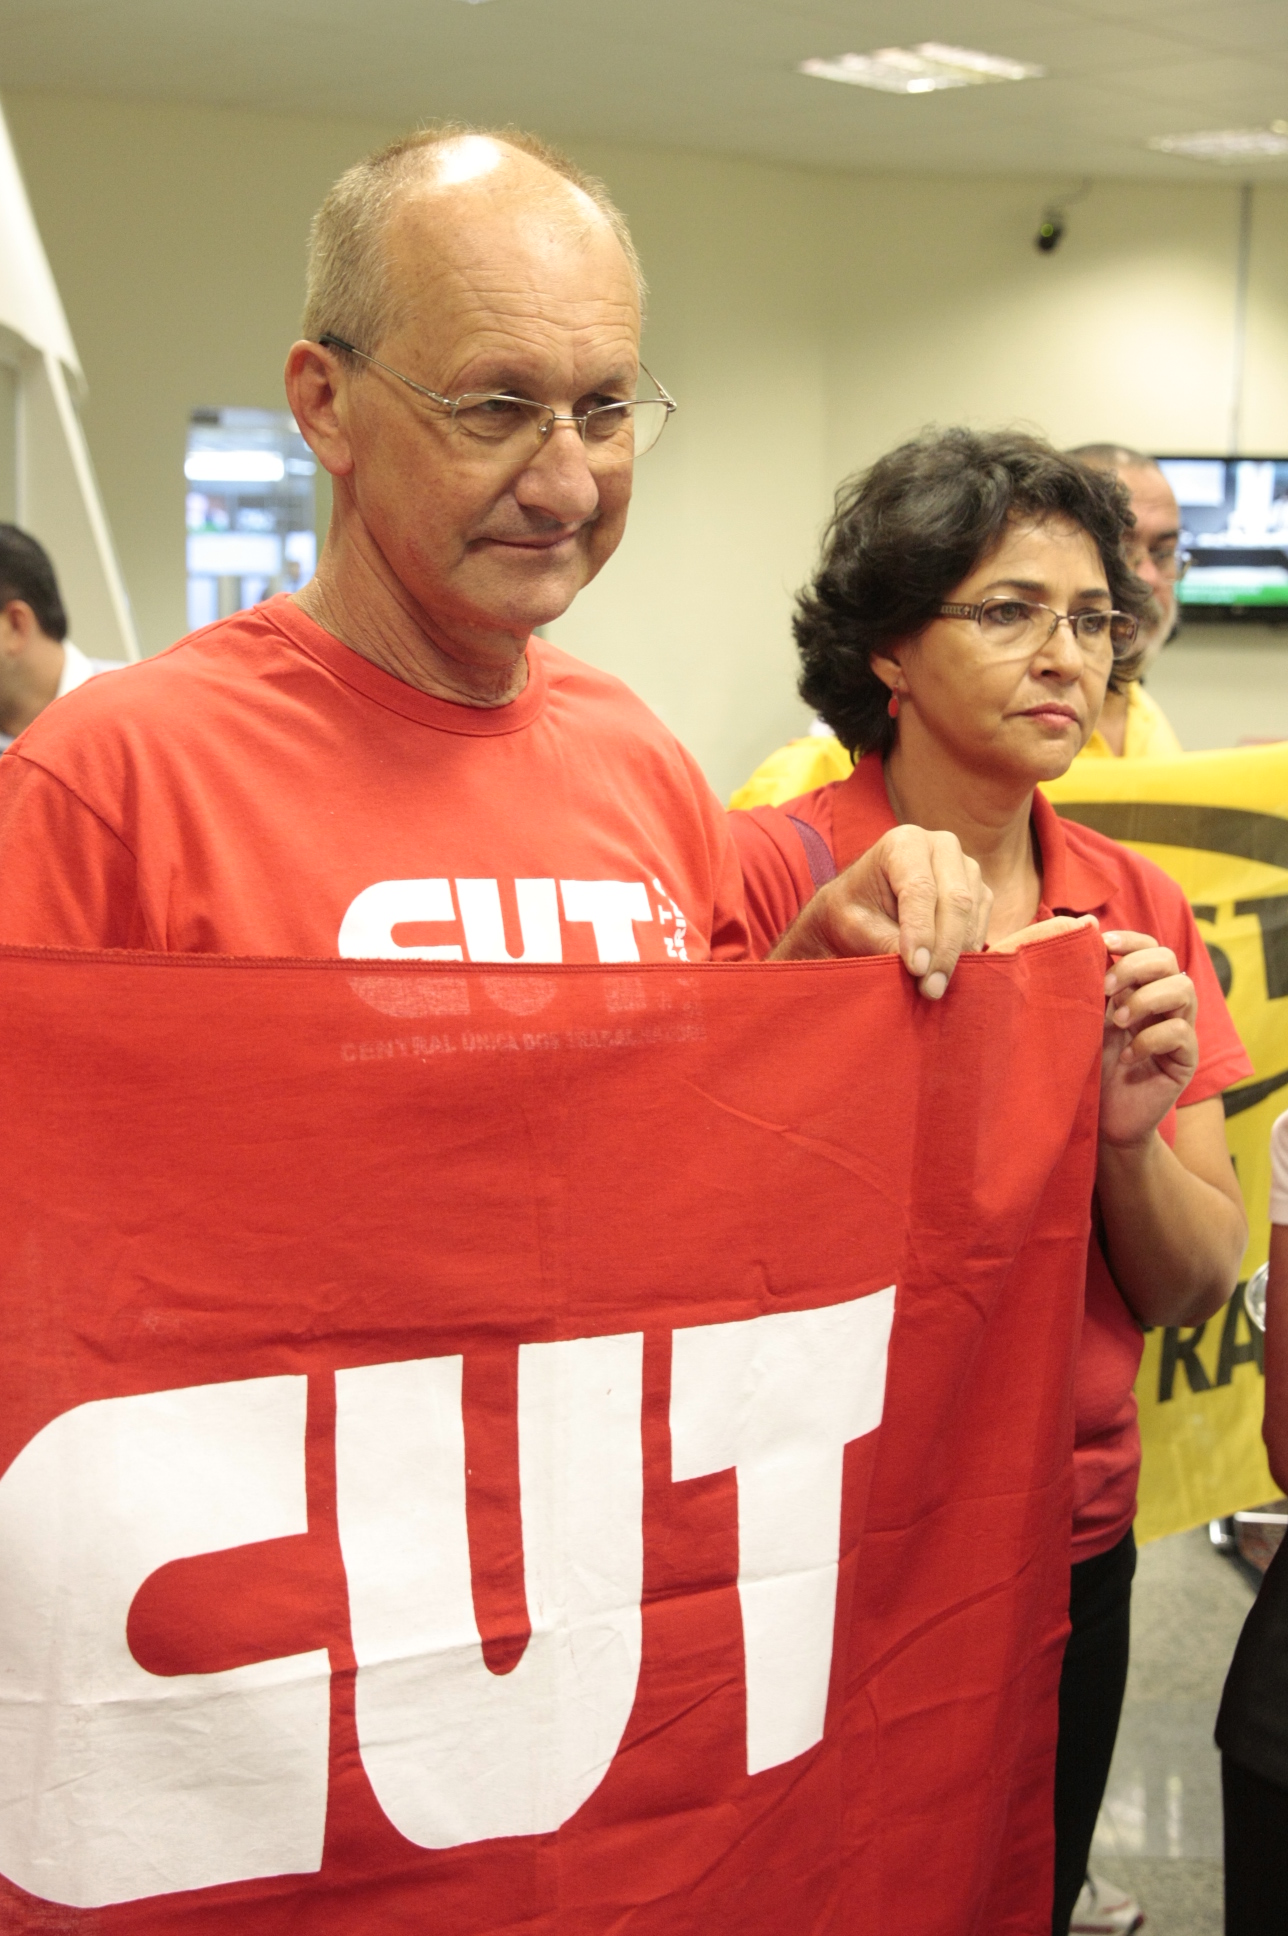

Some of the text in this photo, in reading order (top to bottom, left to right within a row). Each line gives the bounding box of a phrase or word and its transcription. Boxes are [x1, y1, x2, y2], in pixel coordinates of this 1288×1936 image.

[338, 878, 653, 1017] CUT
[340, 1034, 457, 1062] CENTRAL
[1142, 1281, 1264, 1404] RA
[0, 1285, 896, 1908] CUT
